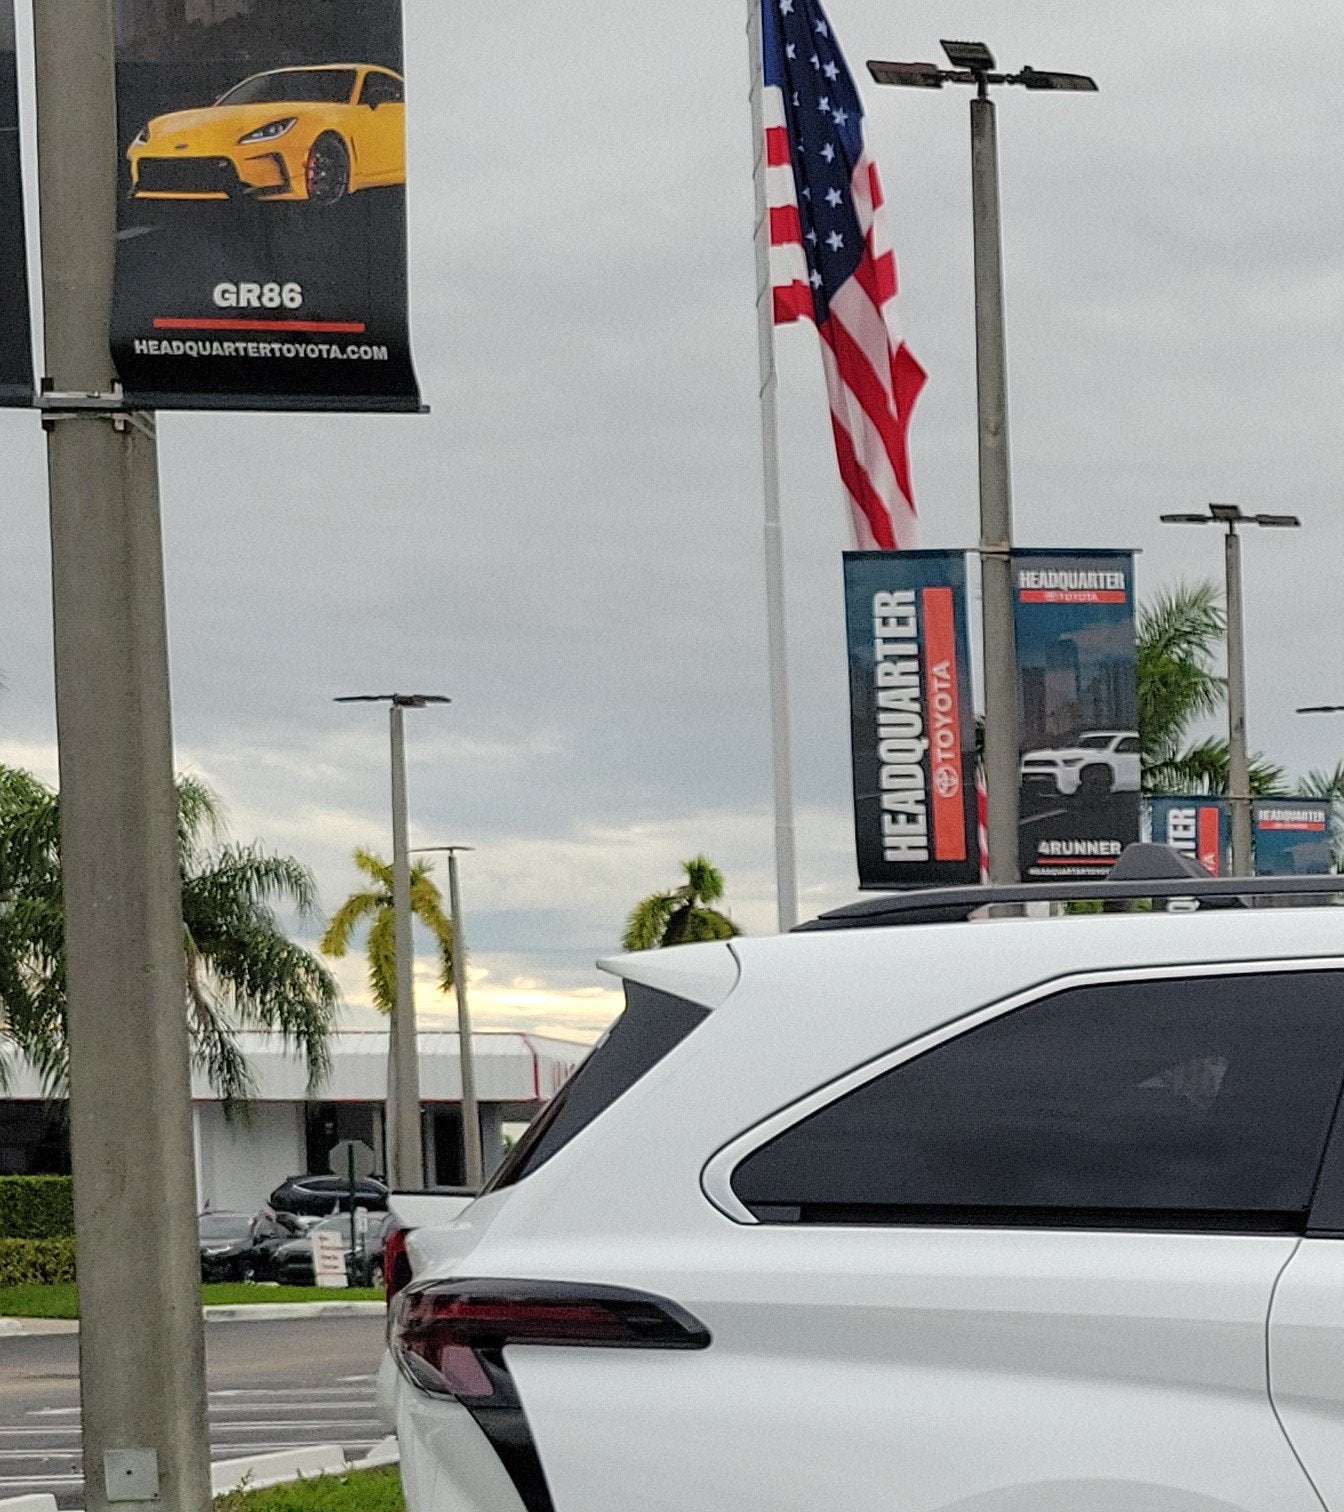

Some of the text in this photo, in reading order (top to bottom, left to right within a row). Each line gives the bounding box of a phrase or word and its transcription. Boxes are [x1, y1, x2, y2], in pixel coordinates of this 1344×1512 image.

[213, 282, 303, 309] GR86
[134, 339, 388, 361] HEADQUARTERTOYOTA.COM
[1019, 570, 1125, 592] HEADQUARTER
[931, 662, 957, 762] TOYOTA
[873, 588, 930, 862] HEADQUARTER
[1037, 840, 1121, 856] 4RUNNER
